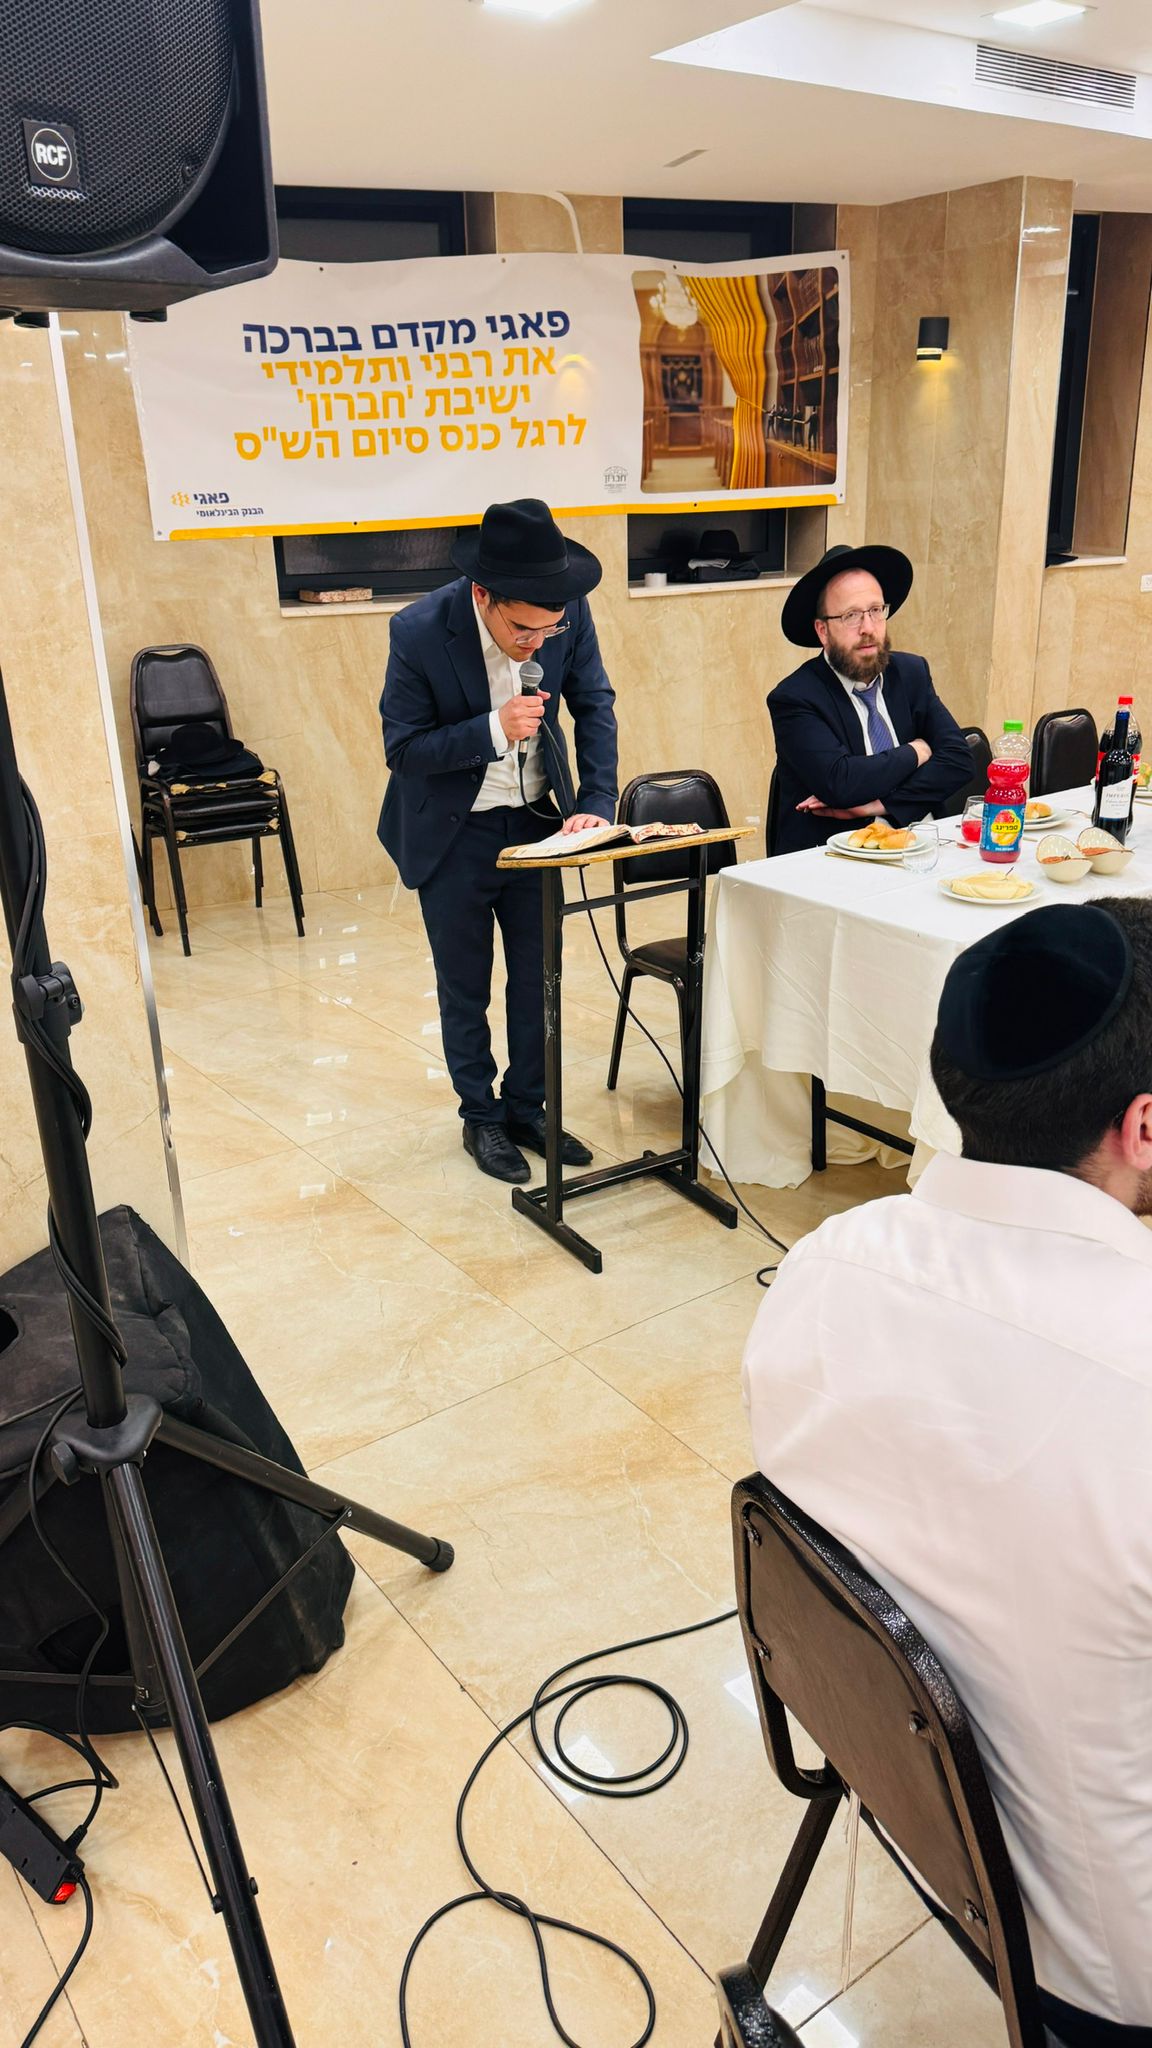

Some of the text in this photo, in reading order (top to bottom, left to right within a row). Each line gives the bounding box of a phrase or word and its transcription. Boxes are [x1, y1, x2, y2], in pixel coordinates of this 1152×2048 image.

[35, 143, 67, 166] RCF
[243, 310, 570, 354] פאגי מקדם בברכה
[261, 347, 556, 386] את רבני ותלמידי
[425, 384, 531, 417] ישיבת
[234, 413, 587, 460] לרגל כנס סיום הש"ס
[193, 492, 230, 505] פאגי
[196, 507, 264, 517] הבנק הבינלאומי
